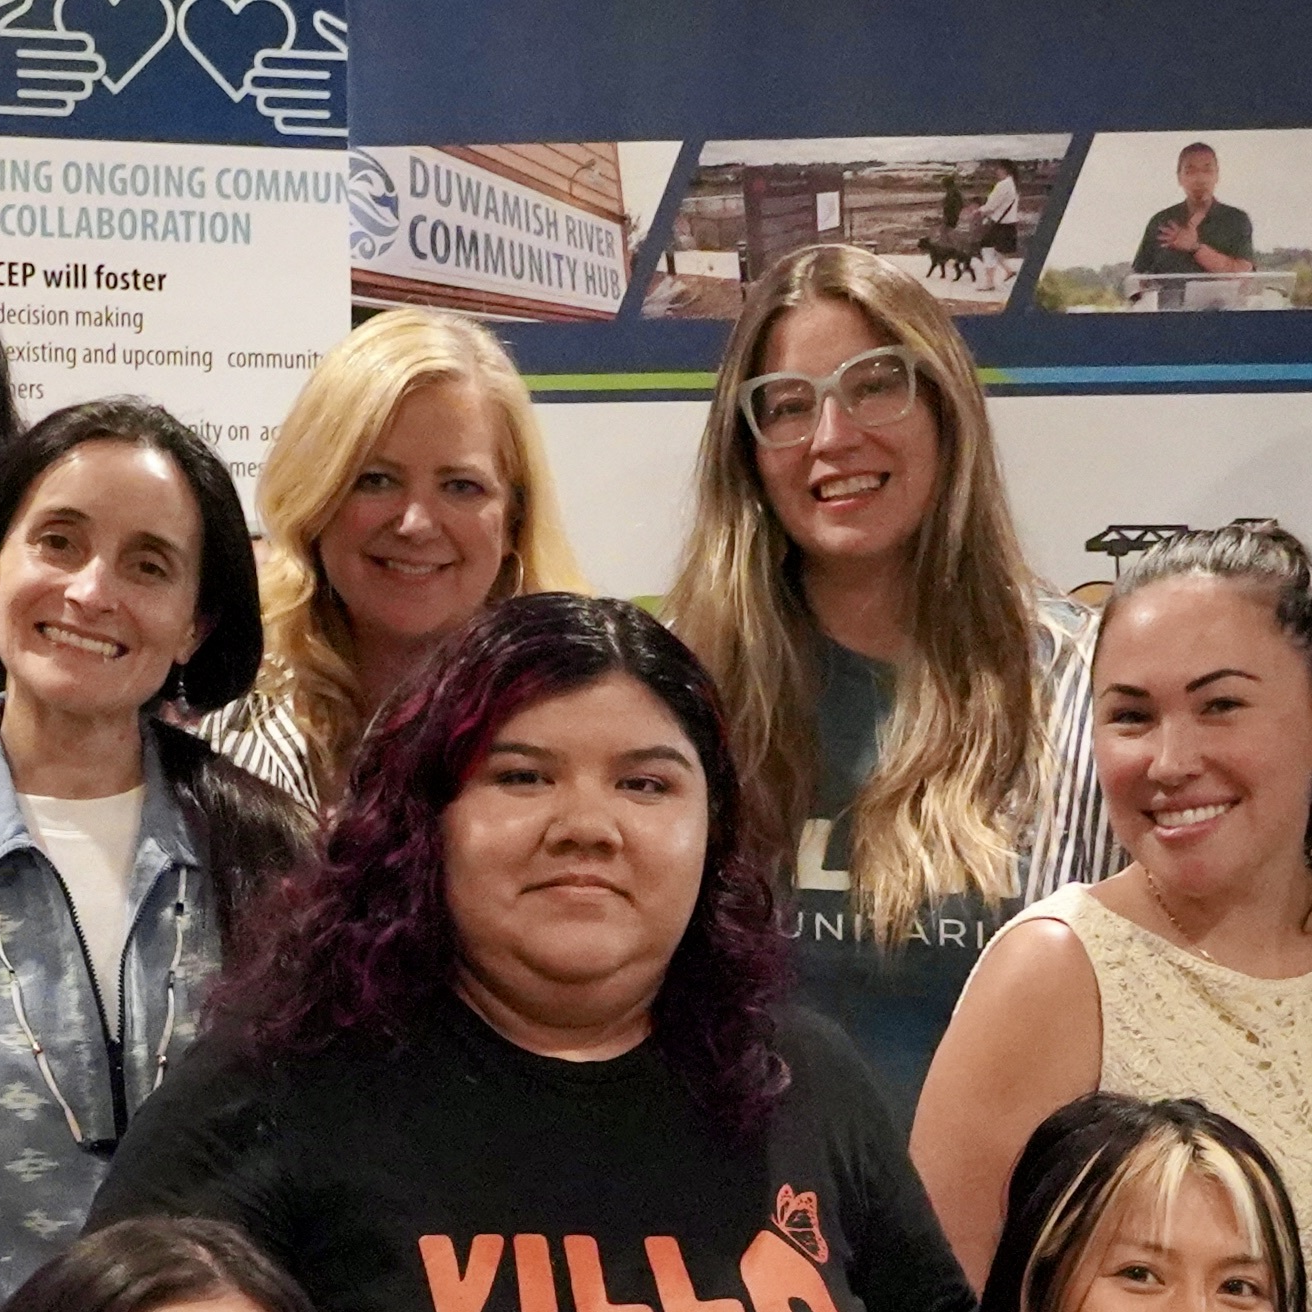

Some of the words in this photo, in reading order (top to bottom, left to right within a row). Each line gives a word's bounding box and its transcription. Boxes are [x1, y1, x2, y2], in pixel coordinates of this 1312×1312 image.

[63, 161, 205, 199] ONGOING
[0, 204, 250, 244] COLLABORATION
[409, 156, 559, 242] DUWAMISH
[566, 215, 616, 259] RIVER
[409, 214, 577, 292] COMMUNITY
[584, 269, 621, 300] HUB
[44, 264, 86, 288] will
[95, 265, 166, 291] foster
[76, 306, 143, 334] making
[6, 342, 76, 370] existing
[83, 343, 116, 364] and
[123, 349, 212, 372] upcoming
[227, 350, 324, 370] communit
[228, 425, 249, 440] on
